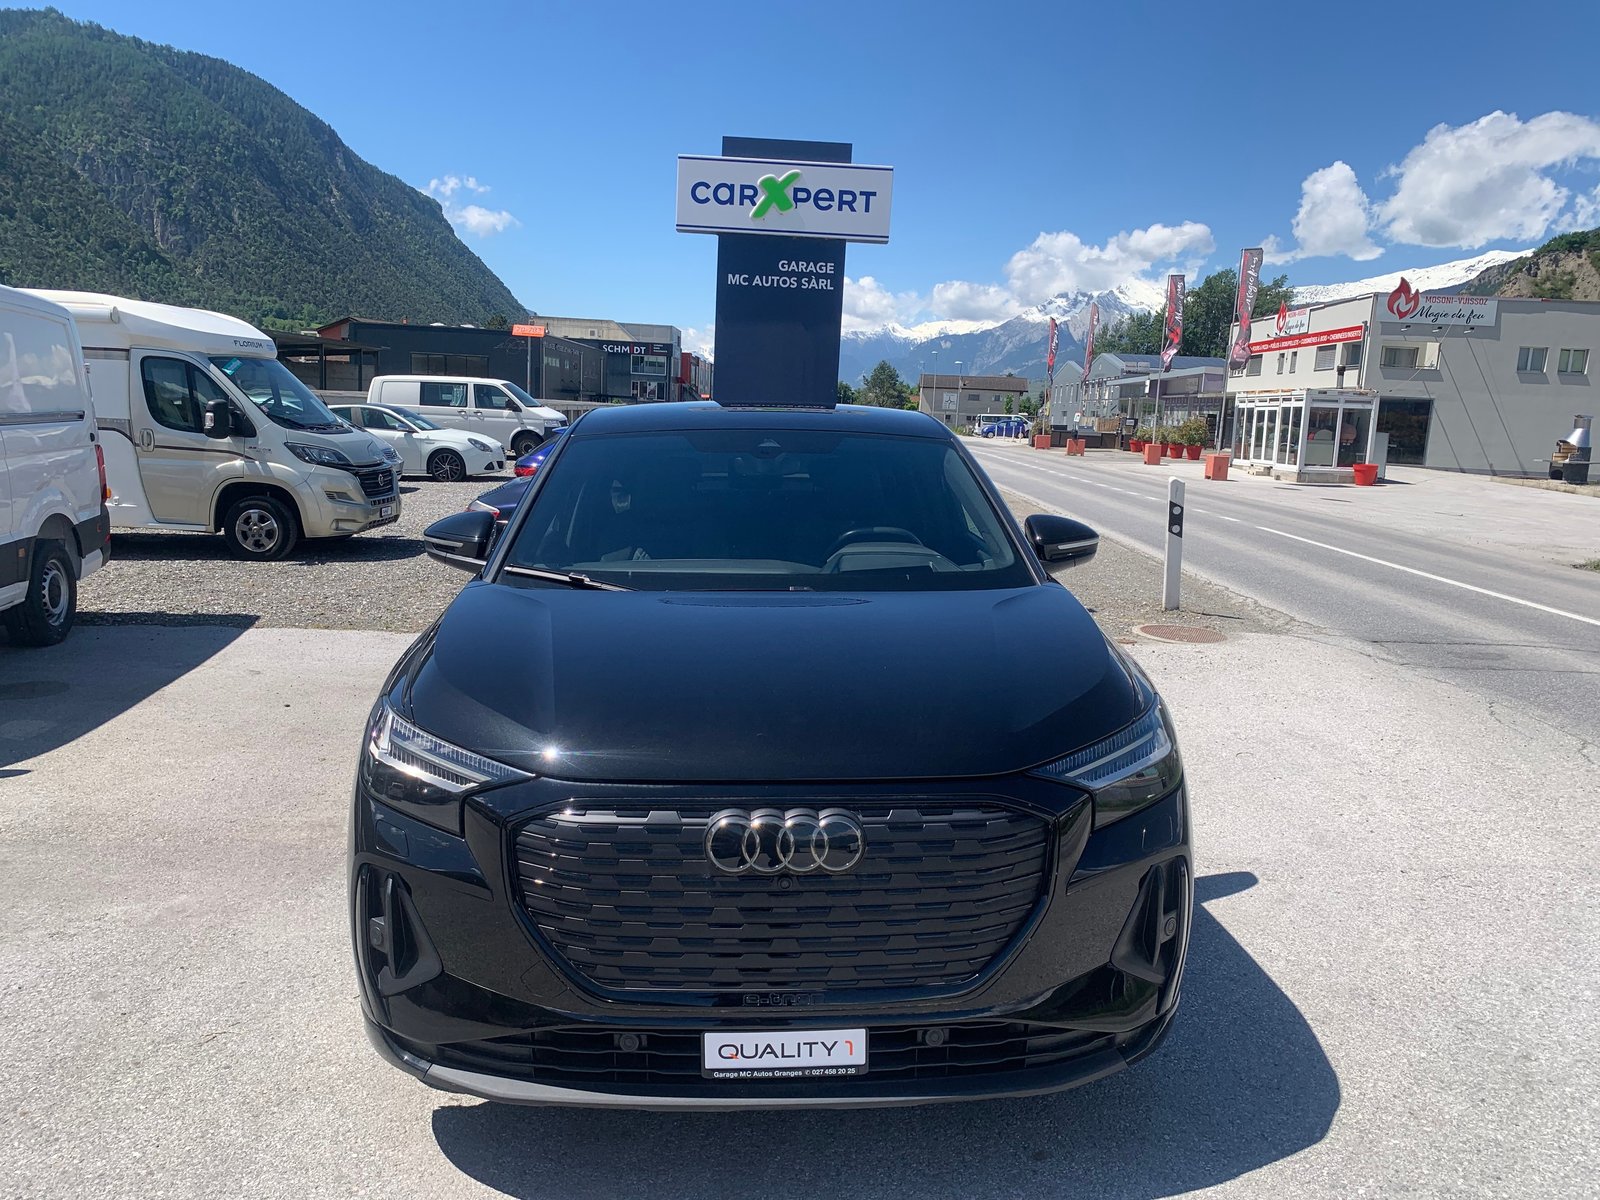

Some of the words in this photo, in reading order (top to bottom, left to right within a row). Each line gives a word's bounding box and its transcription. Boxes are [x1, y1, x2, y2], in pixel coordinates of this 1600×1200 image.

[779, 260, 835, 274] GARAGE
[727, 273, 749, 286] MC
[752, 276, 798, 289] AUTOS
[801, 275, 834, 290] SÀRL
[1425, 296, 1488, 306] MOSONI-VUISSOZ
[1409, 305, 1450, 323] Magie
[1451, 308, 1465, 319] du
[1465, 308, 1485, 324] feu
[602, 343, 646, 355] SCHMIDT
[718, 1041, 838, 1059] QUALITY
[844, 1040, 854, 1056] 1
[713, 1071, 738, 1079] Garage
[774, 1070, 802, 1078] Granges
